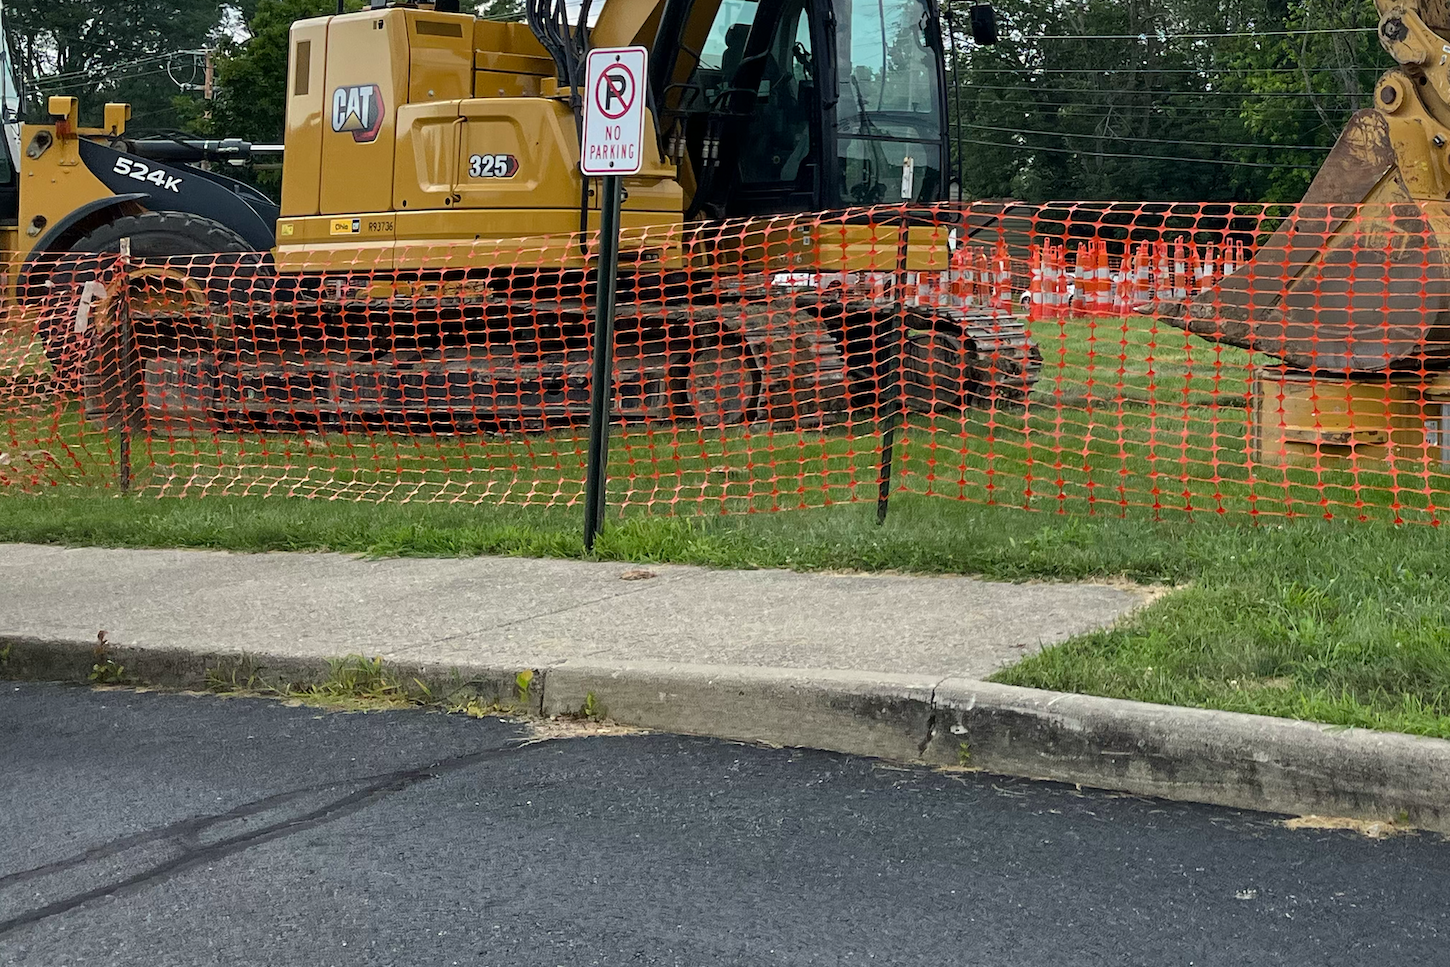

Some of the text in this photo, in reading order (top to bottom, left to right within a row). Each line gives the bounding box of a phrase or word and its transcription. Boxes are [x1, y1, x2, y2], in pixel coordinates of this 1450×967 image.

[333, 85, 373, 132] CAT
[605, 125, 621, 141] NO
[589, 143, 634, 160] PARKING
[112, 156, 183, 193] 524K
[469, 154, 508, 177] 325
[368, 221, 394, 232] R93736
